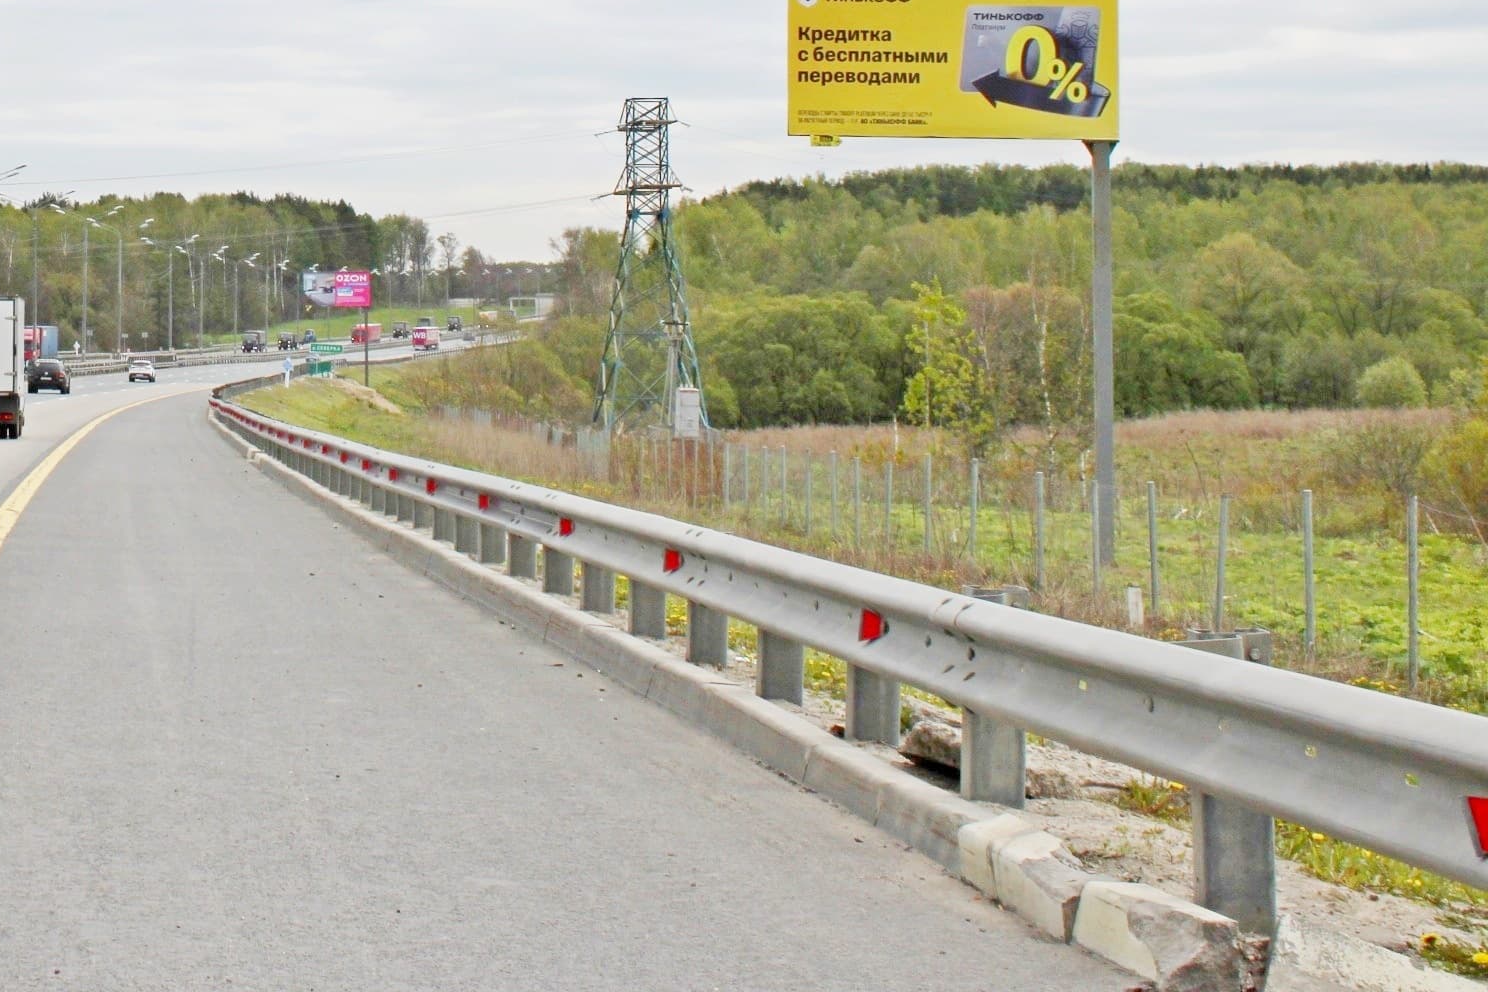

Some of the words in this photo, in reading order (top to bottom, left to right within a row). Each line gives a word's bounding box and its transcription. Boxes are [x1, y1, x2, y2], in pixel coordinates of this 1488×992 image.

[973, 12, 1045, 21] ТИНЬКОФФ
[798, 26, 892, 45] Кредитка
[797, 49, 809, 62] с
[813, 46, 949, 63] бесплатными
[1005, 25, 1088, 103] 0%
[798, 70, 921, 86] переводами
[336, 274, 367, 282] OZON
